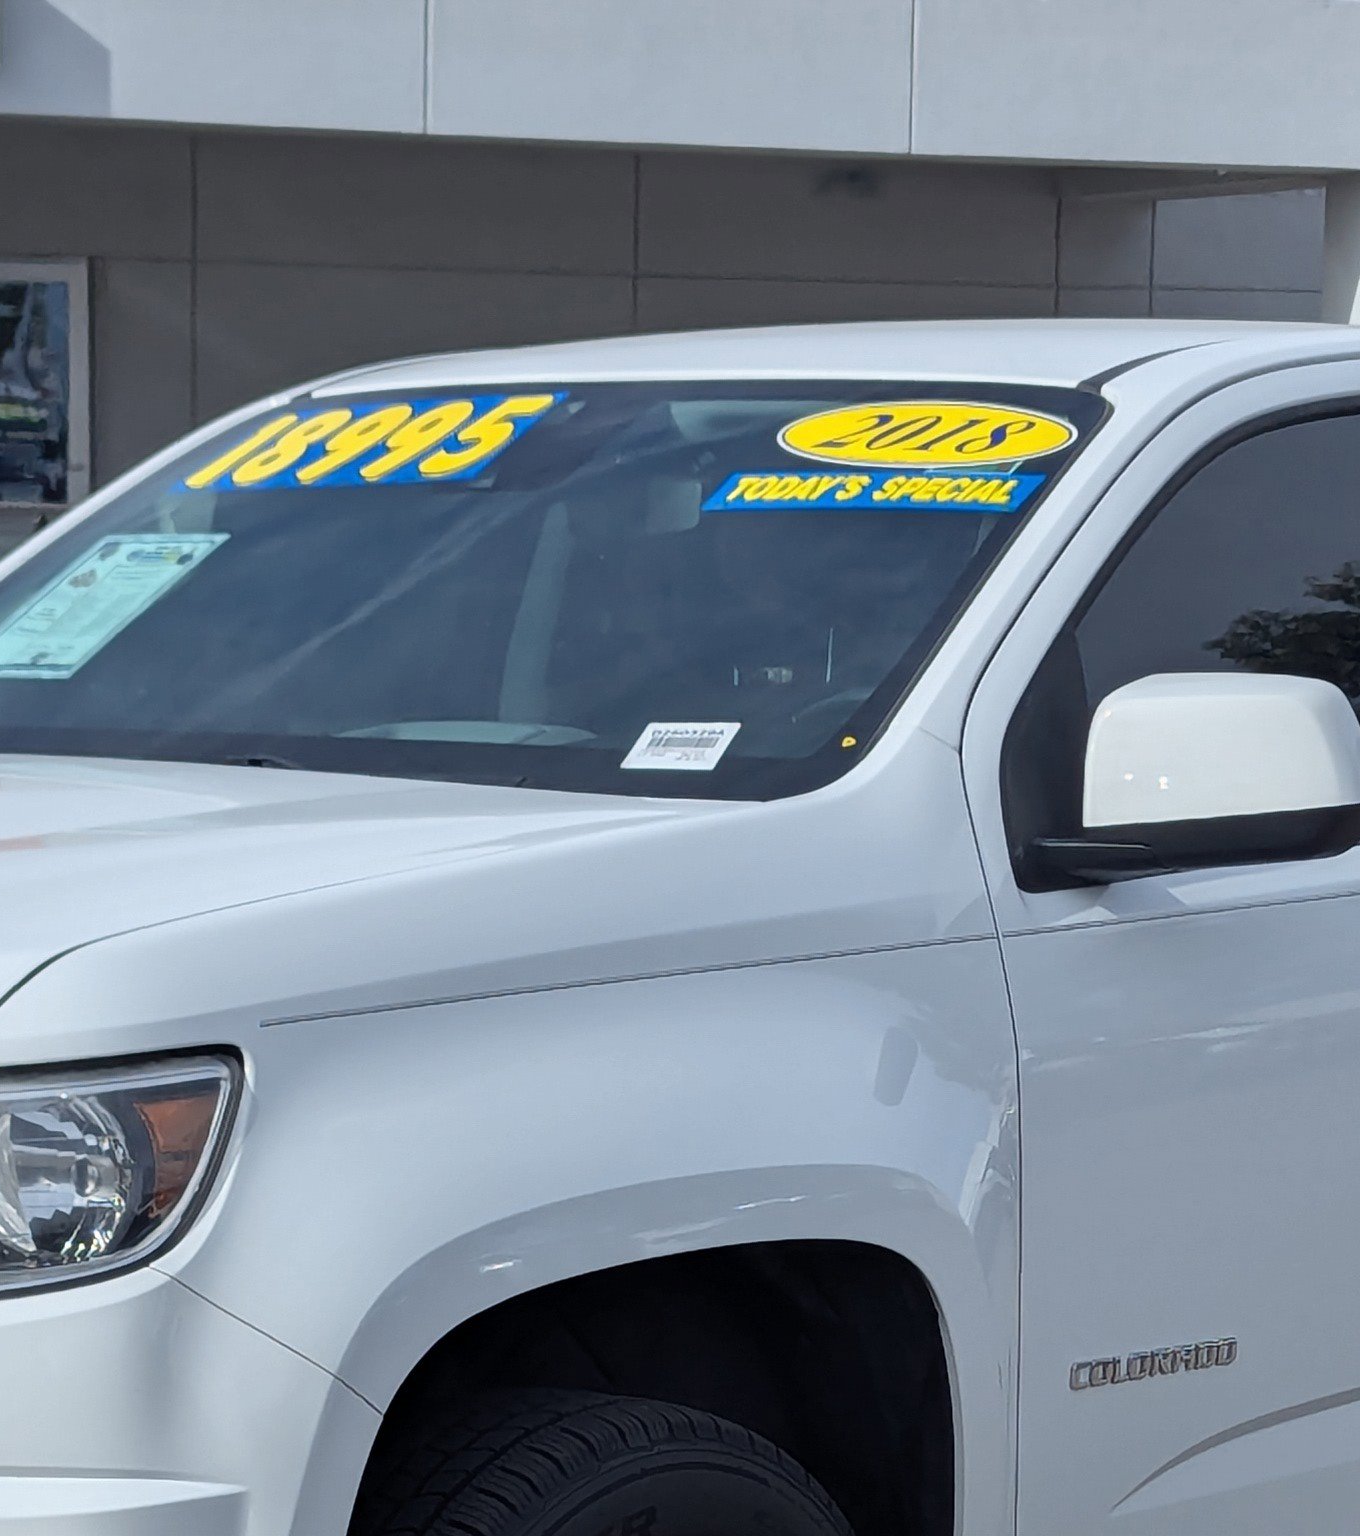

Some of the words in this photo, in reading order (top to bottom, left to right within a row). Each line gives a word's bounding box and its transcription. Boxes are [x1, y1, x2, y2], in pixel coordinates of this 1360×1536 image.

[184, 393, 555, 488] 18995
[813, 414, 1036, 454] 2018
[726, 475, 871, 502] TODAY'S
[872, 475, 1018, 505] SPECIAL
[1069, 1337, 1238, 1391] COLORADO
